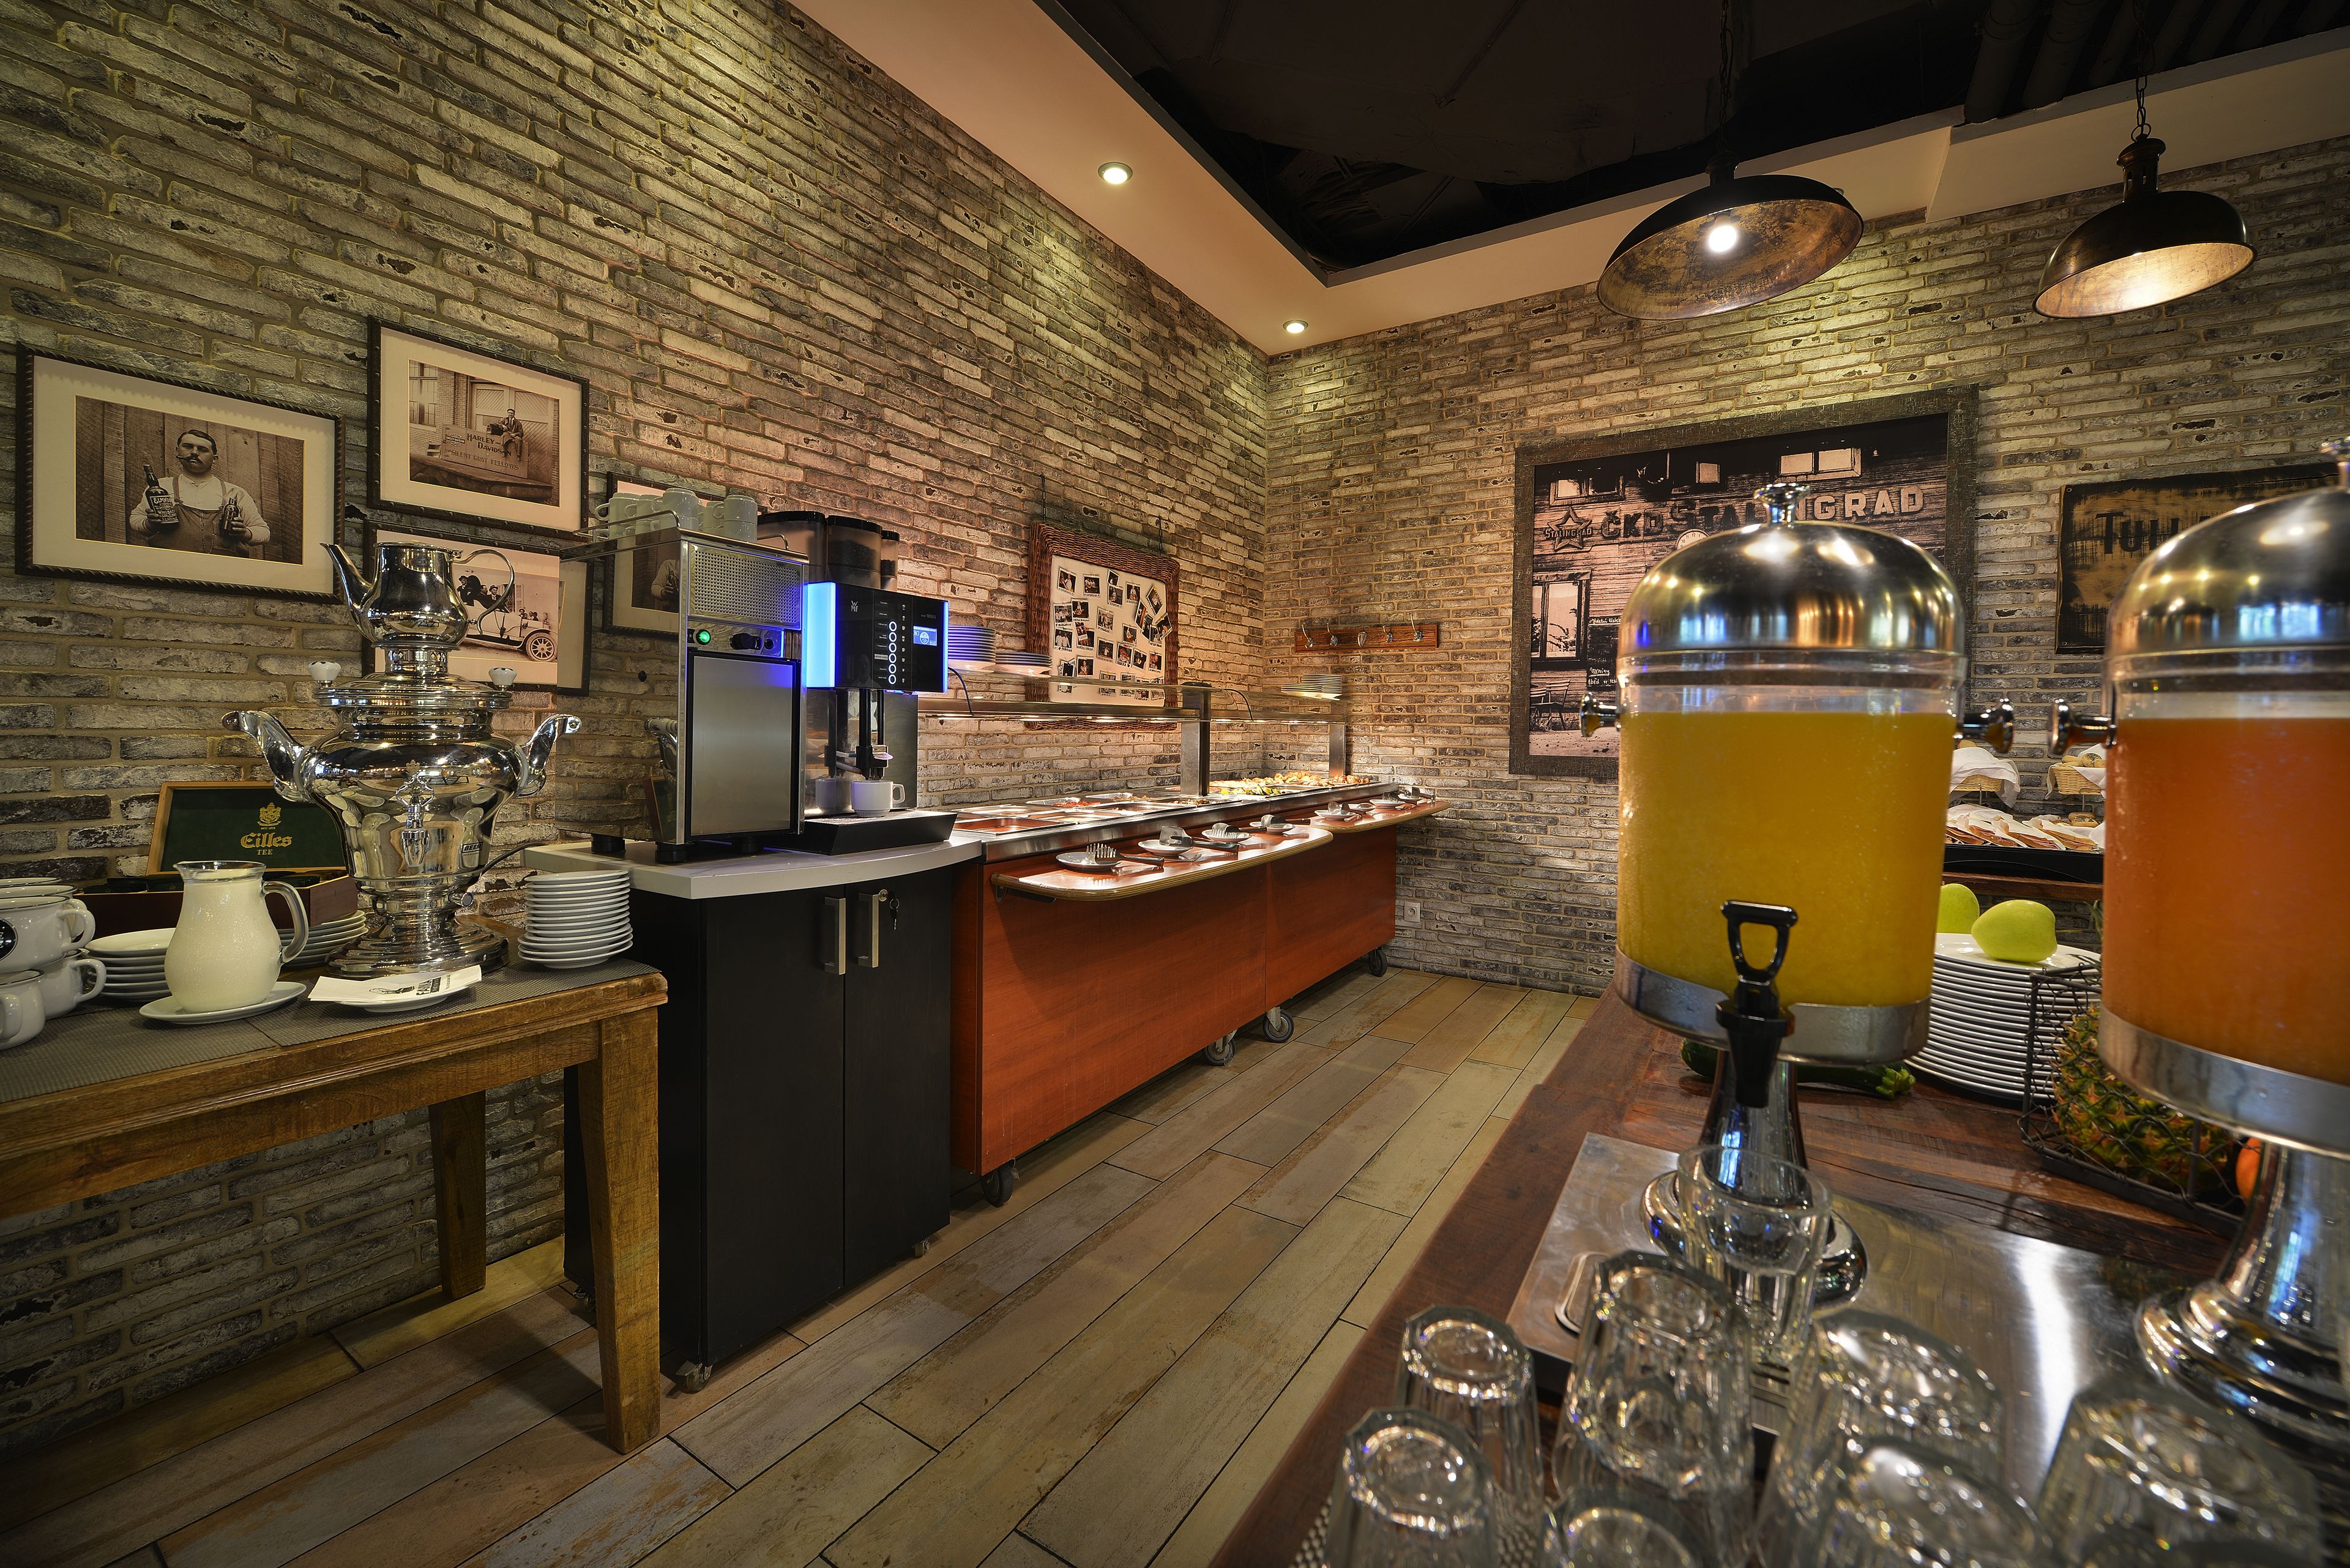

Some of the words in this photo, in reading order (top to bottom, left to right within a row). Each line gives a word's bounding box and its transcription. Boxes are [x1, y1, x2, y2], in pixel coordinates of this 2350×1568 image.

[450, 450, 472, 459] SILENT
[490, 459, 519, 471] FELLOWS
[1671, 487, 1924, 531] STALGRAD
[1545, 527, 1592, 539] STALINGRAD
[241, 832, 293, 848] Eilles
